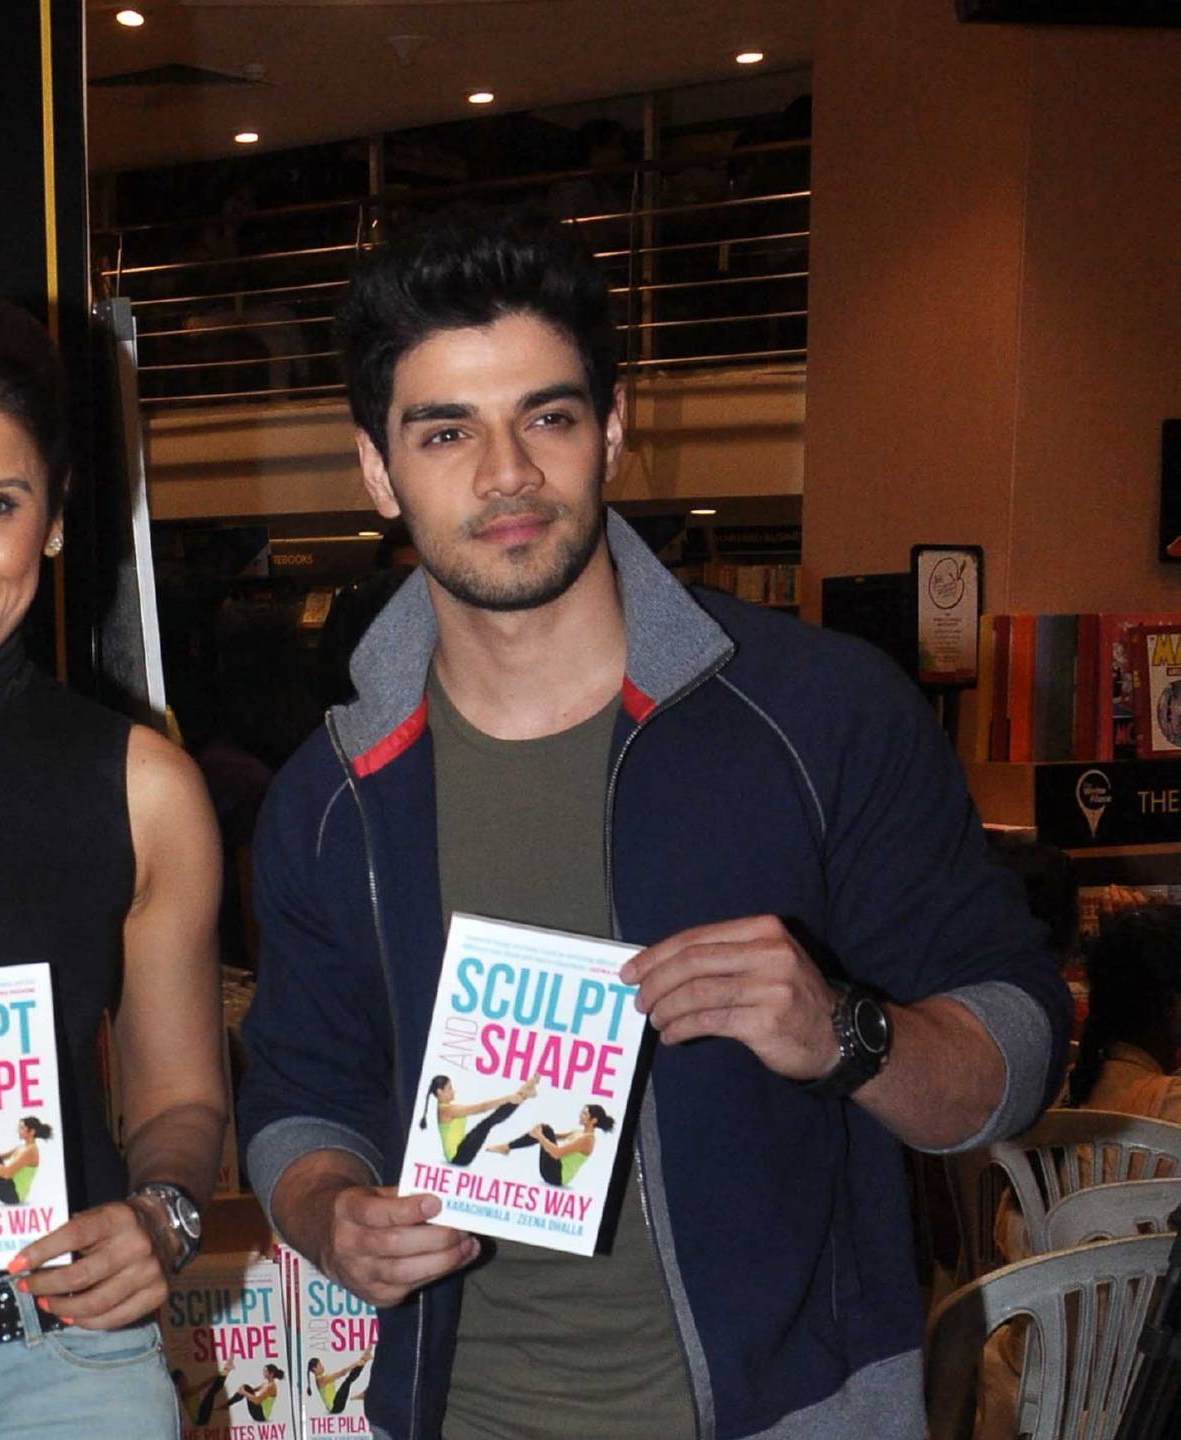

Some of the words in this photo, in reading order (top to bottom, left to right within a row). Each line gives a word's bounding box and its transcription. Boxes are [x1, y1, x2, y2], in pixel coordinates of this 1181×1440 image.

[1137, 789, 1180, 815] THE
[451, 956, 637, 1042] SCULPT
[439, 1016, 479, 1071] AND
[475, 1023, 623, 1099] SHAPE
[414, 1162, 453, 1194] THE
[455, 1171, 540, 1211] PILATES
[544, 1190, 593, 1222] WAY
[8, 1207, 53, 1235] WAY
[517, 1213, 546, 1228] ZEENA
[548, 1219, 583, 1236] DHALLA
[170, 1287, 273, 1328] SCULPT
[192, 1325, 279, 1364] SHAPE
[257, 1423, 286, 1440] WAY
[310, 1417, 334, 1434] THE
[338, 1415, 366, 1433] PILA
